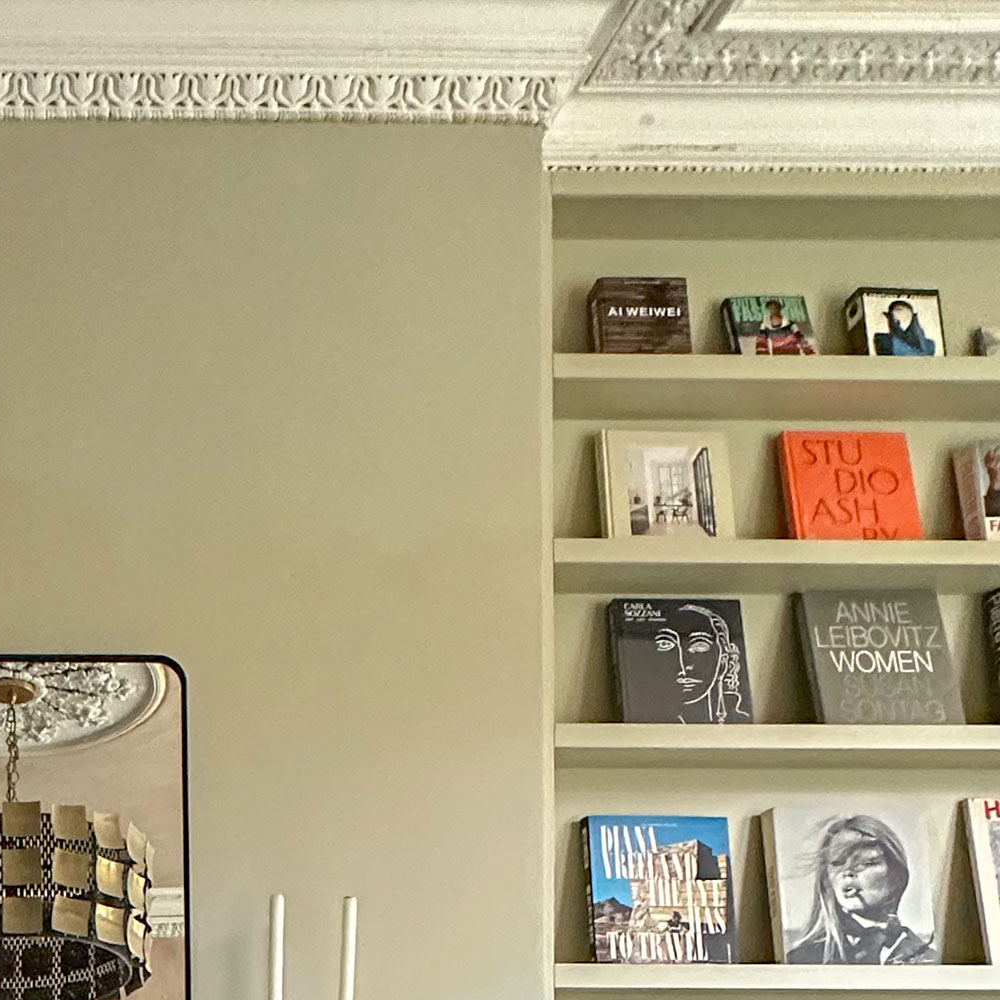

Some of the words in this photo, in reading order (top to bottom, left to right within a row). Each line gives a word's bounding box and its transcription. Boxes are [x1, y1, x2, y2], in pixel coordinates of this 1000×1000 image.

[607, 306, 622, 317] AI
[626, 306, 682, 318] WEIWEI
[801, 439, 862, 466] STU
[834, 468, 899, 495] DIO
[810, 497, 879, 525] ASH
[835, 601, 913, 624] ANNIE
[814, 625, 943, 648] LEIBOVITZ
[829, 650, 934, 673] WOMEN
[601, 825, 659, 853] DIANA
[602, 851, 699, 880] VREELAND
[606, 931, 634, 960] TO
[637, 931, 709, 961] TRAVEL
